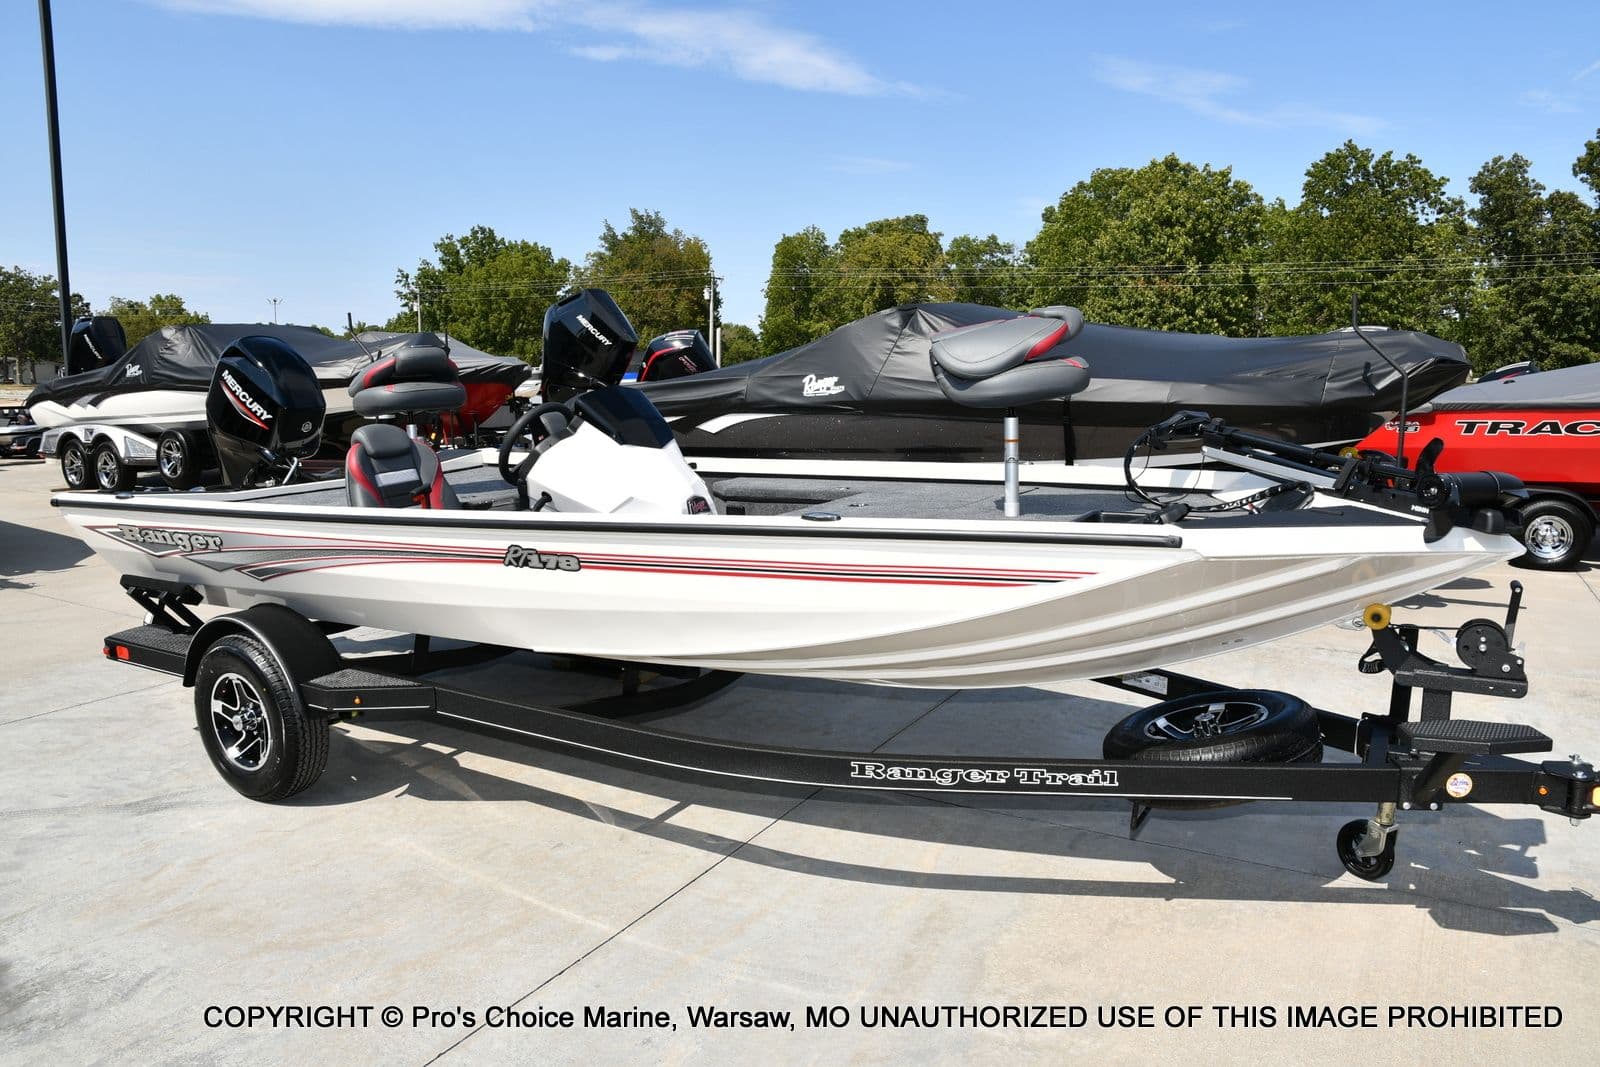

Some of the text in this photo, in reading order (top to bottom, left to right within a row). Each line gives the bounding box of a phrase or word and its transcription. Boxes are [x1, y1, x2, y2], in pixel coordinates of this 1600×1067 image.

[576, 314, 613, 346] MERCURY
[221, 369, 273, 421] MERCURY
[117, 524, 222, 553] Ranger
[851, 761, 1119, 787] Ranger Trail
